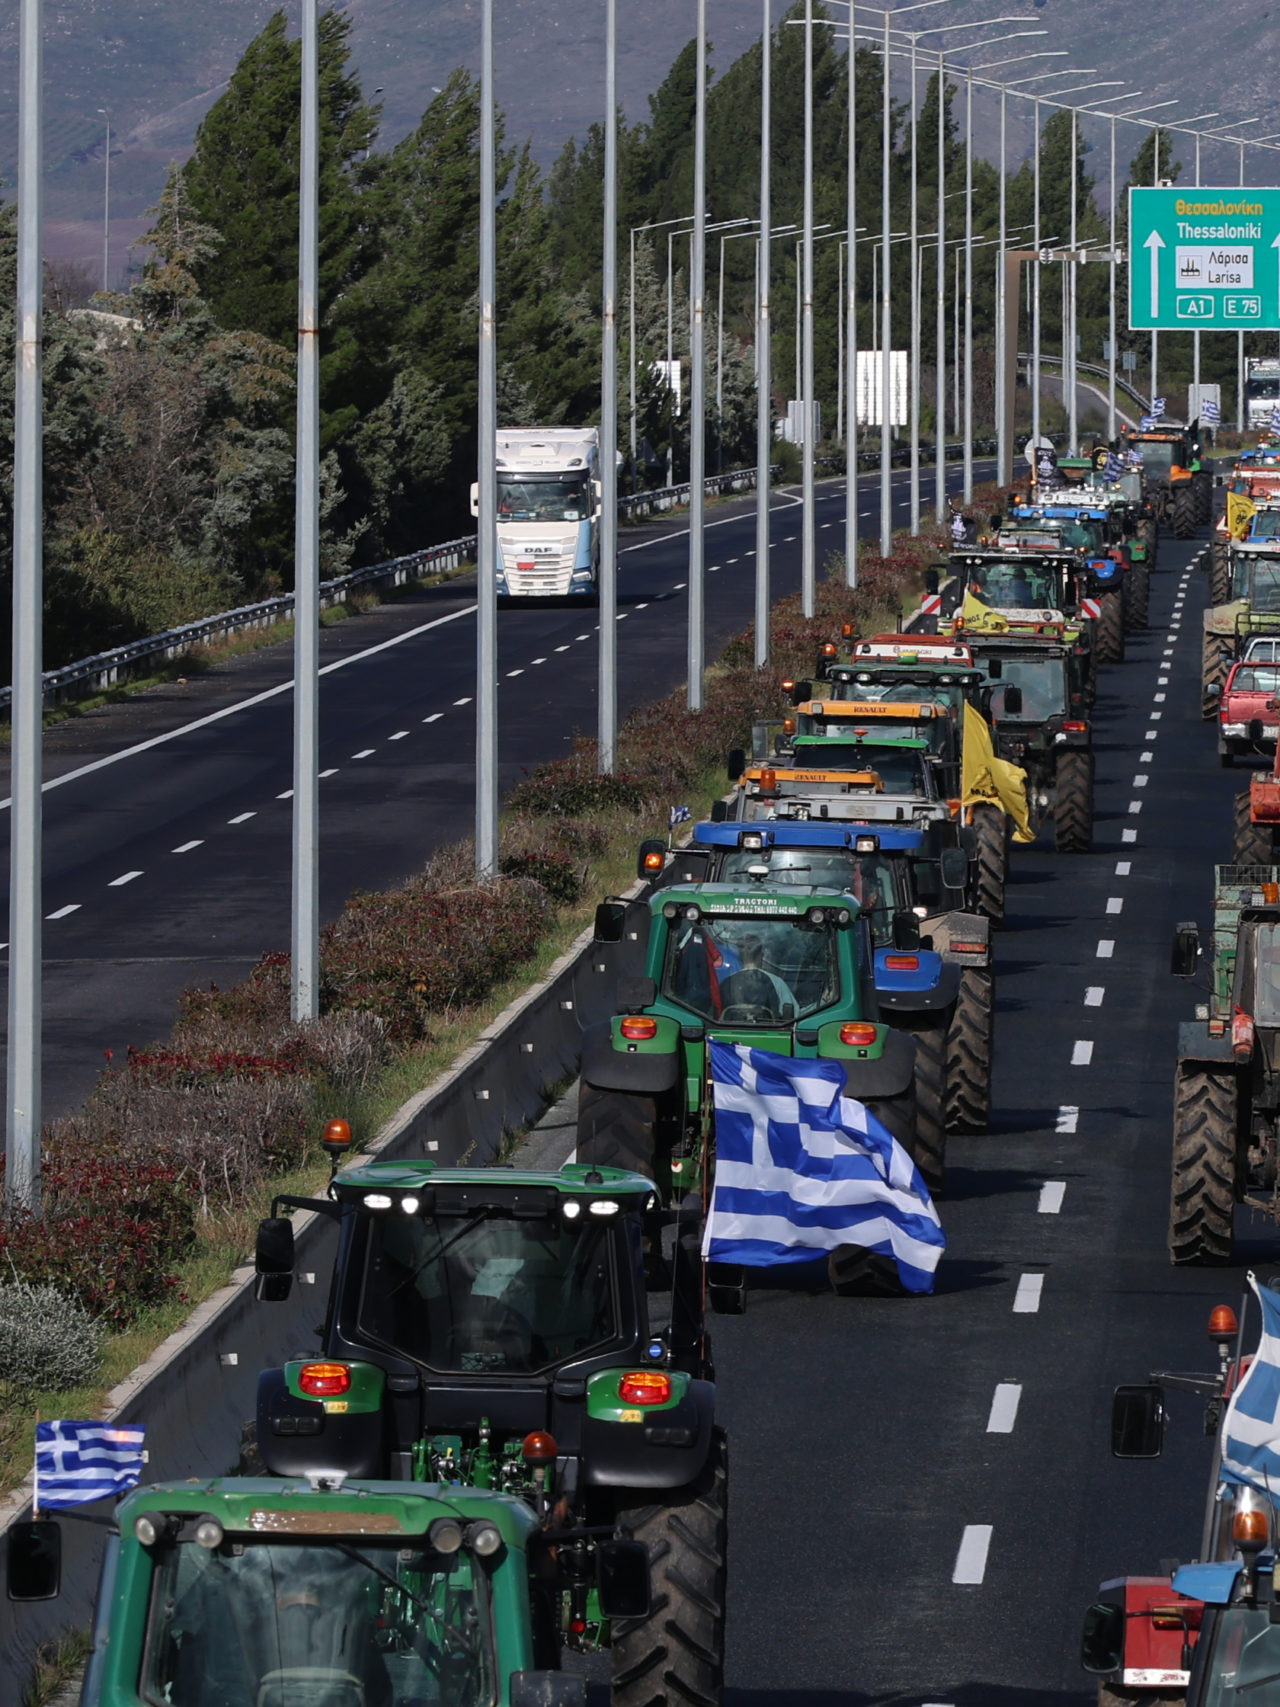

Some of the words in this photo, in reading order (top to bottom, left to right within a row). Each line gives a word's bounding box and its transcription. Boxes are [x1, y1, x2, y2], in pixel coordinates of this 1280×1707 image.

[1175, 199, 1263, 216] Θεσσαλονίκη
[1177, 222, 1262, 239] Thessaloniki
[1208, 251, 1249, 267] Λάρισα
[1208, 271, 1241, 284] Larisa
[1187, 300, 1206, 315] A1
[1227, 300, 1237, 314] E
[1242, 300, 1258, 314] 75
